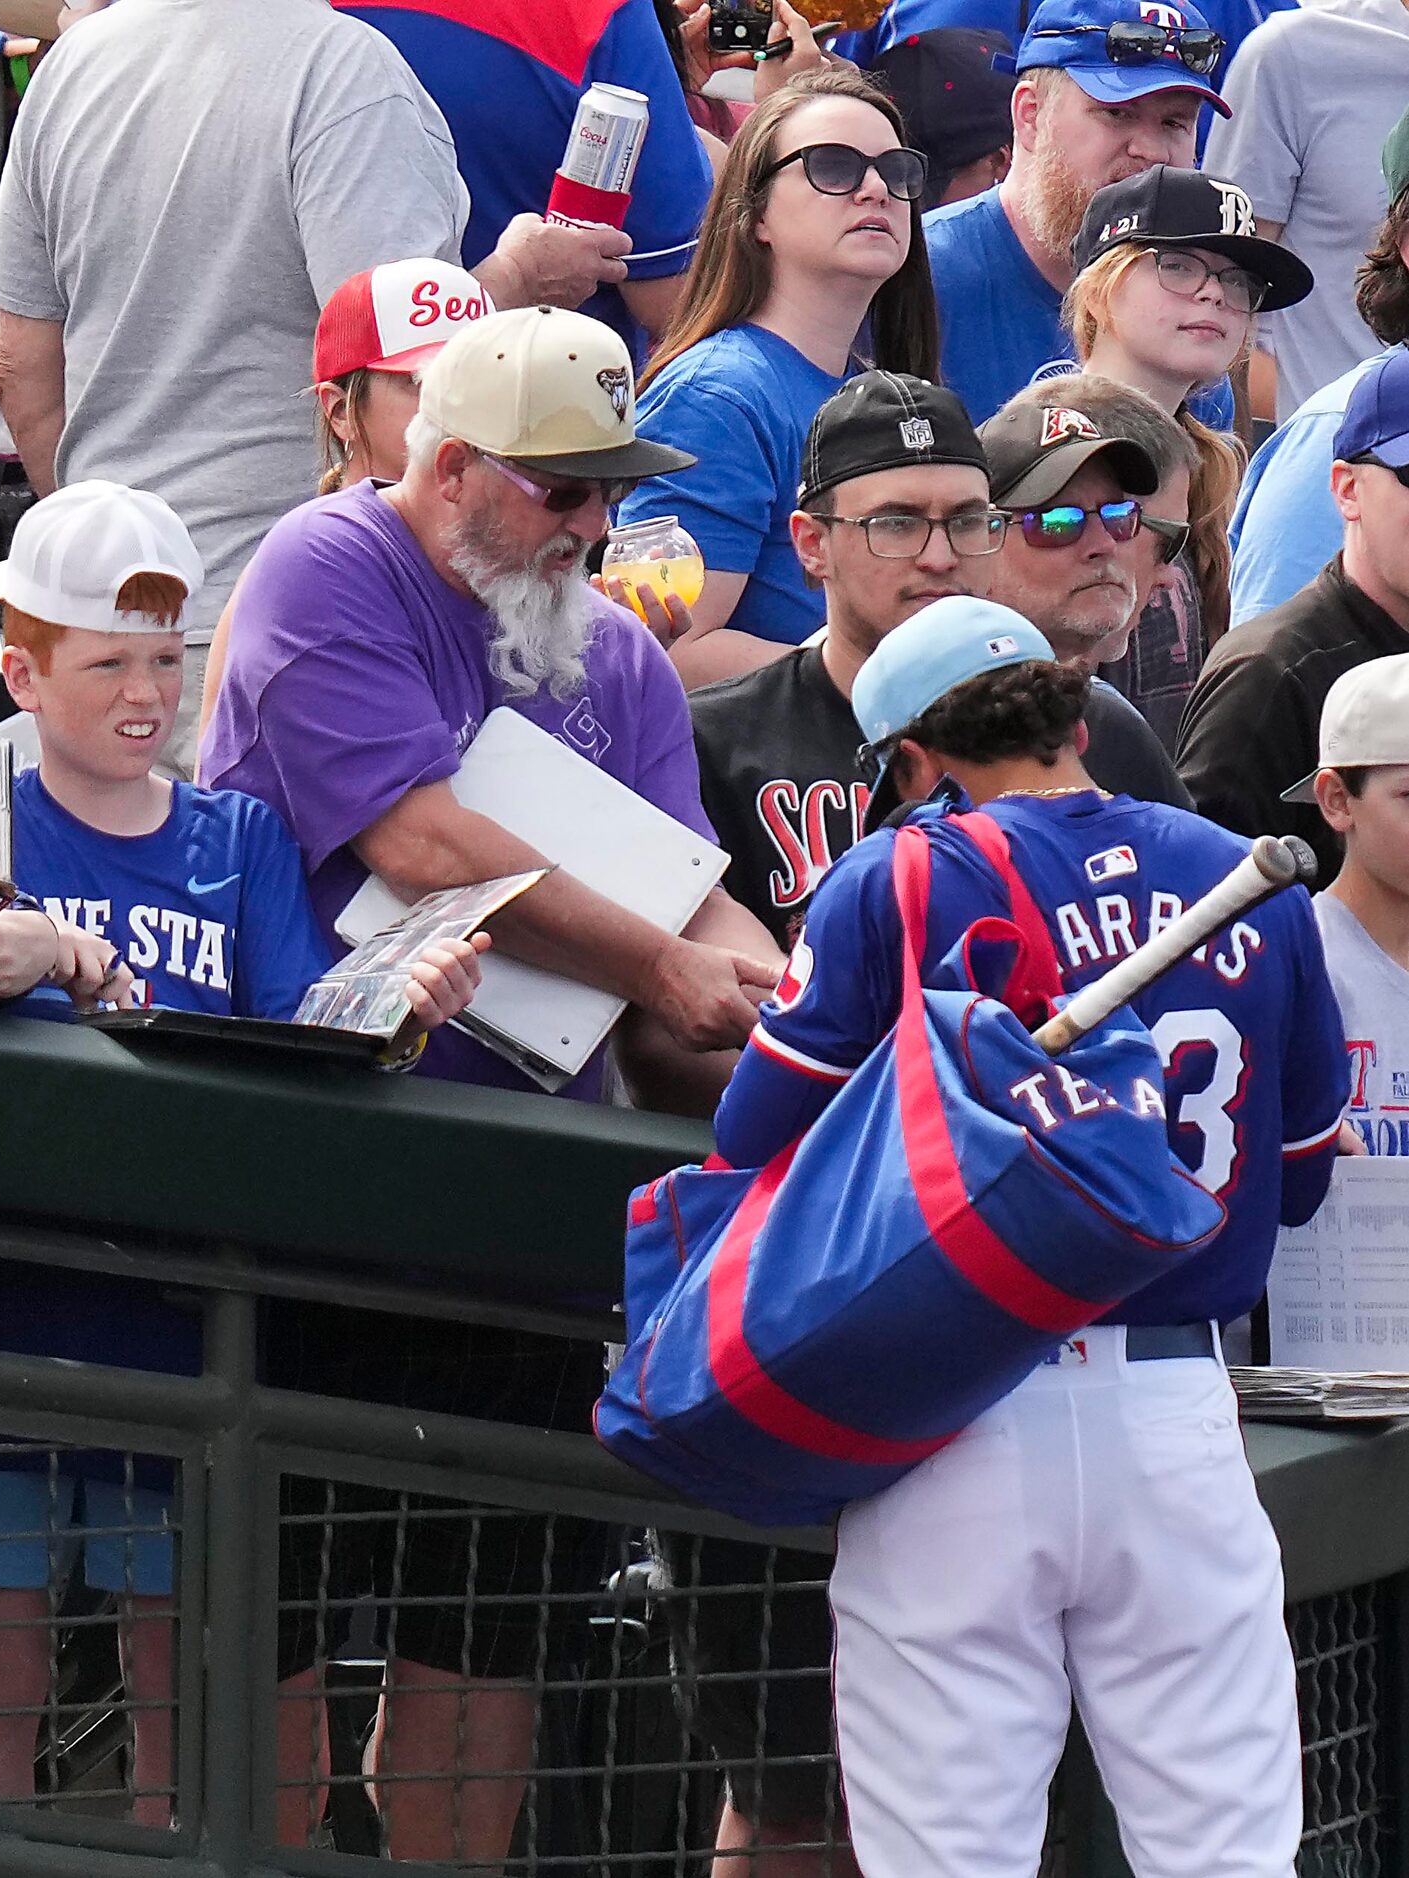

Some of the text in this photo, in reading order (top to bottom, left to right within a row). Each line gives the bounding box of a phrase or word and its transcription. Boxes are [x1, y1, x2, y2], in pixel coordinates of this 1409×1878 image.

[580, 126, 608, 145] Coors
[906, 430, 933, 445] NFL
[128, 904, 235, 998] STA
[1055, 890, 1261, 981] ARRS
